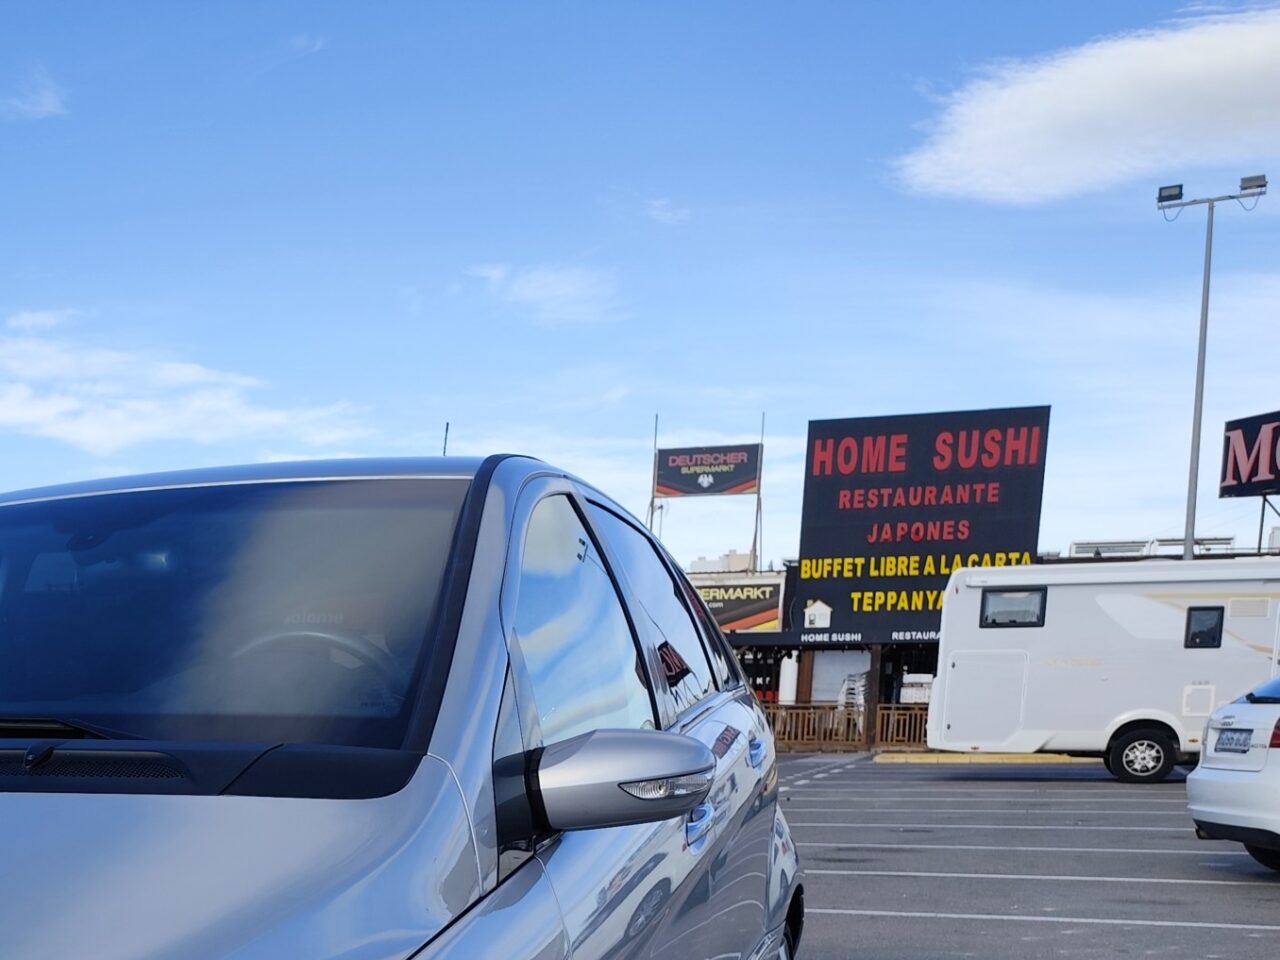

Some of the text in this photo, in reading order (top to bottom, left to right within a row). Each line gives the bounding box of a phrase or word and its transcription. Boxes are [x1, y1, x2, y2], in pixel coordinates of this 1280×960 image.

[668, 452, 748, 467] DEUTSCHER
[812, 426, 1041, 476] HOME SUSHI
[1220, 422, 1280, 487] M
[681, 464, 735, 474] SUPERMARKT
[838, 482, 1000, 509] RESTAURANTE
[867, 520, 970, 543] JAPONES
[800, 557, 865, 579] BUFFET
[870, 555, 920, 577] LIBRE
[923, 554, 936, 575] A
[940, 553, 962, 574] LA
[801, 633, 829, 642] HOME
[831, 632, 862, 642] SUSHI
